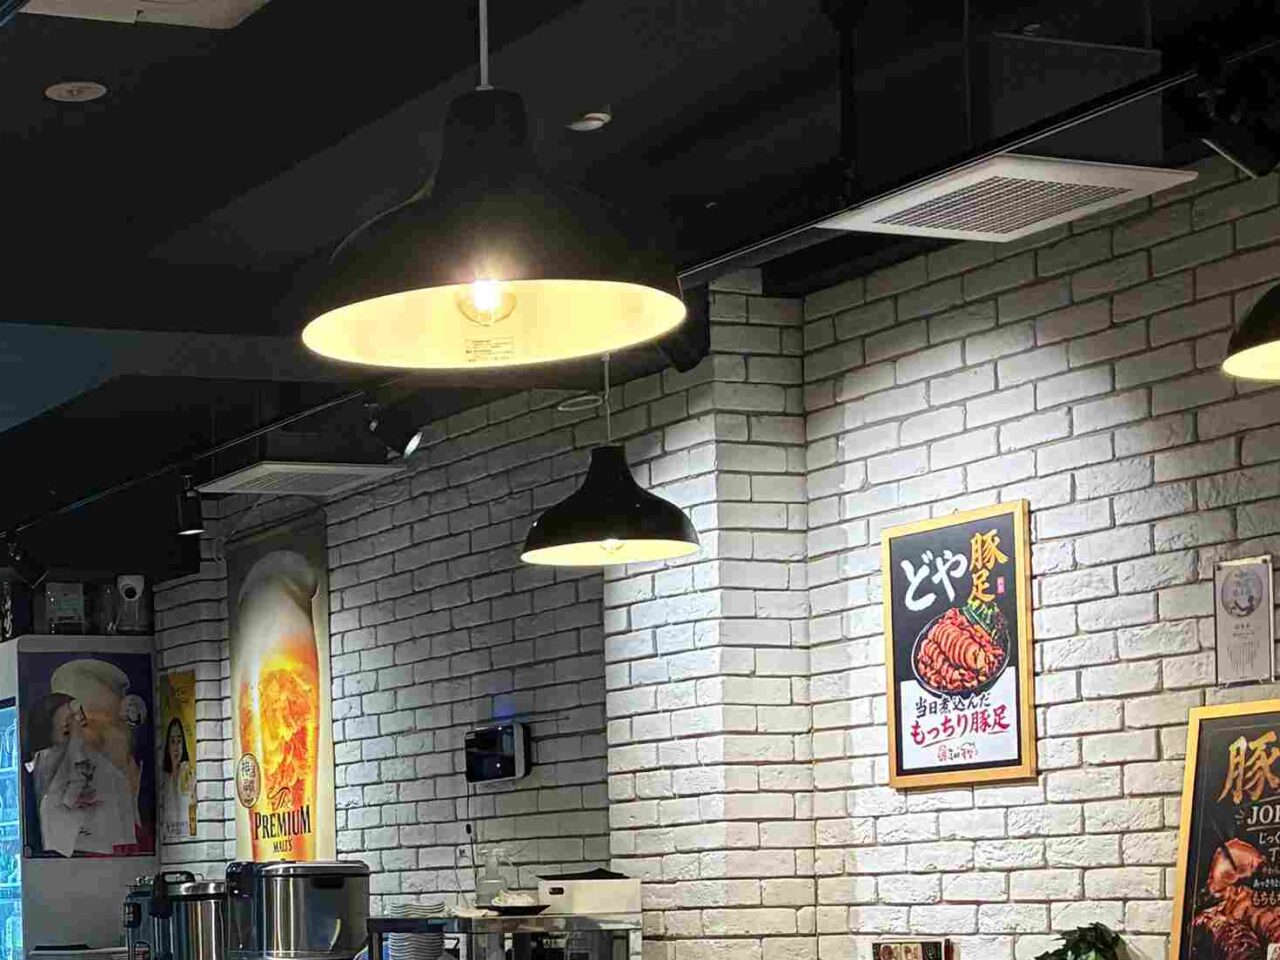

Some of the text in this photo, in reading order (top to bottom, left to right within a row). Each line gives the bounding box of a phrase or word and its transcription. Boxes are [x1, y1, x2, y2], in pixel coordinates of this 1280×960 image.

[901, 550, 968, 611] どや
[969, 529, 1009, 602] 豚足
[910, 704, 1011, 745] もっちり豚足
[915, 692, 992, 719] 当日煮込んだ
[254, 804, 312, 841] PREMIUM
